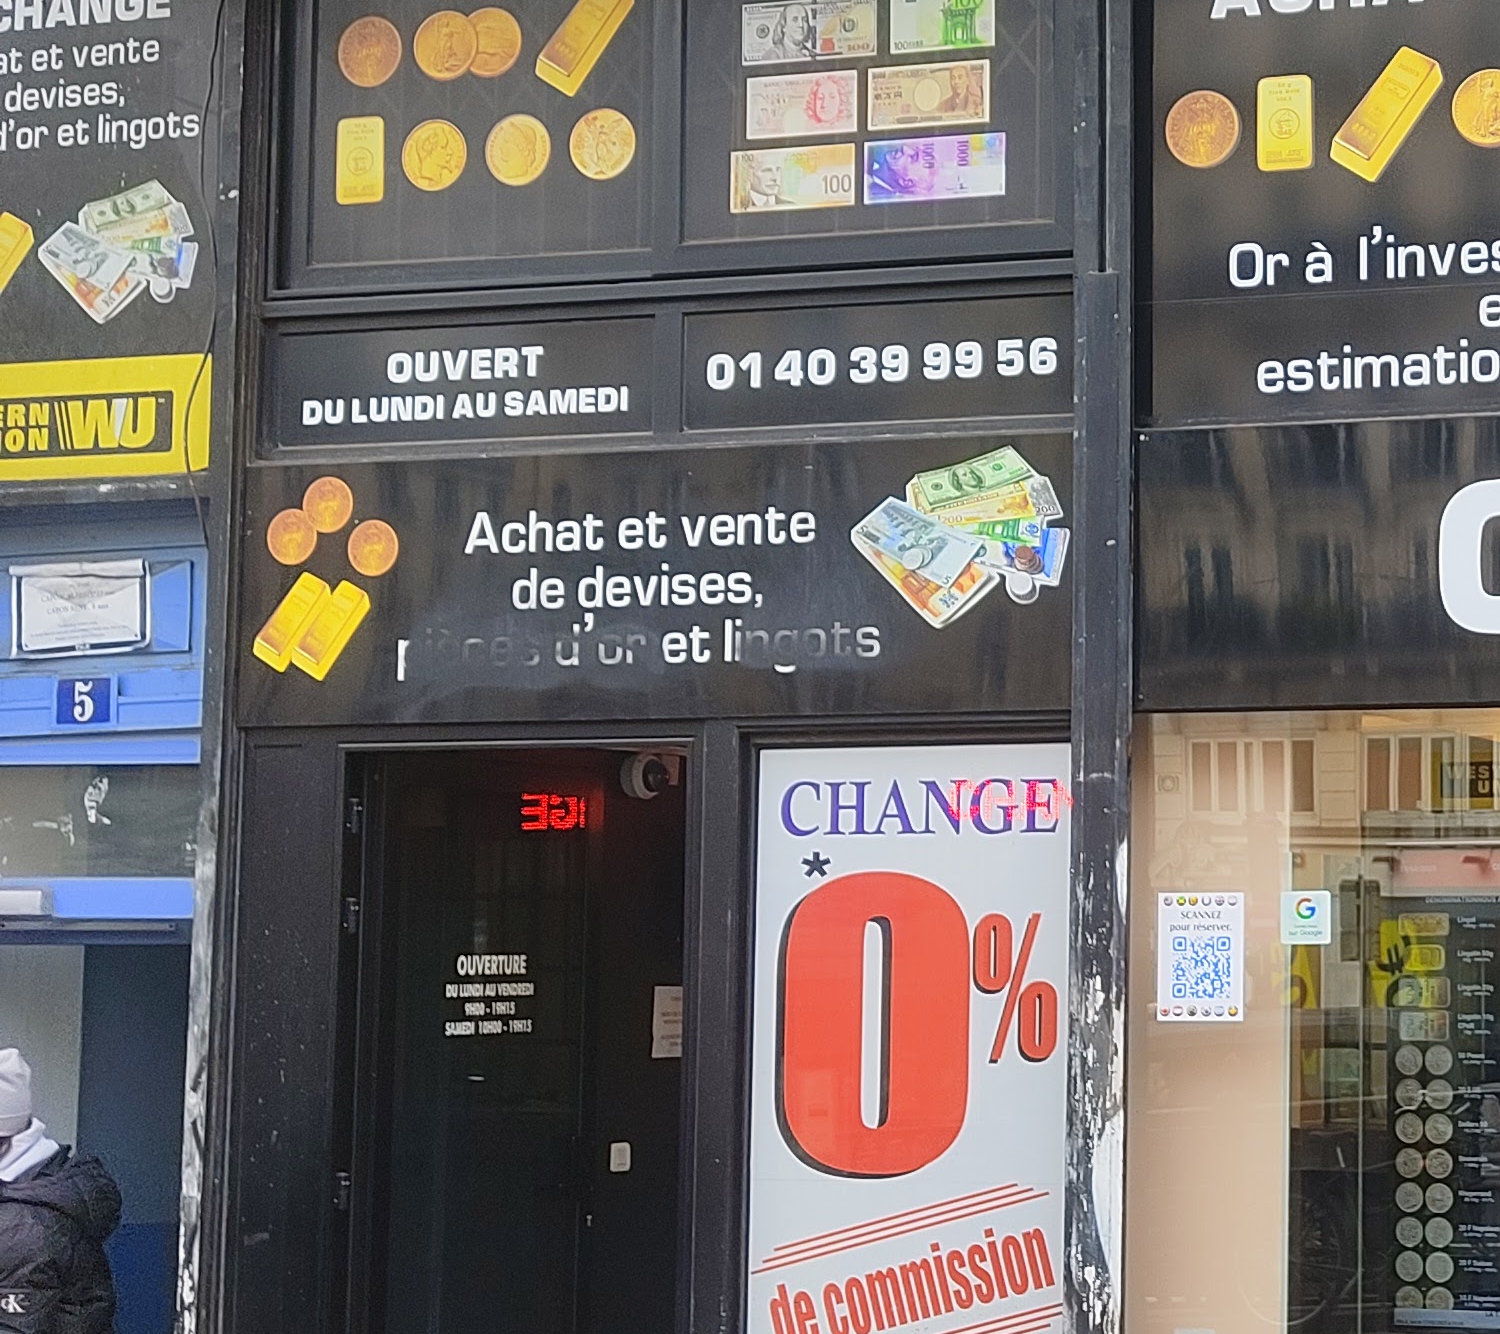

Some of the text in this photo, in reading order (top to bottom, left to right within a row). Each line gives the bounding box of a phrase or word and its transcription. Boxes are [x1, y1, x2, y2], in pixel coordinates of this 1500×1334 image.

[32, 43, 63, 72] et
[73, 38, 160, 68] vente
[5, 78, 125, 113] devises,
[58, 119, 89, 147] et
[98, 111, 199, 150] lingots
[822, 174, 851, 194] 100
[1228, 242, 1289, 288] Or
[1305, 240, 1331, 284] à
[386, 346, 544, 384] OUVERT
[706, 336, 1058, 392] 01 40 39 99 56
[0, 397, 155, 450] RN WU
[302, 385, 629, 426] DU LUNDI AU SAMEDI
[0, 428, 48, 452] ON
[465, 506, 816, 554] Achat et vente
[512, 566, 764, 611] de devises,
[661, 627, 710, 664] et
[724, 619, 880, 673] lingots
[74, 680, 94, 722] 5
[781, 779, 1059, 836] CHANGE
[1170, 924, 1190, 932] pour
[1181, 911, 1221, 919] SCANNEZ
[457, 955, 527, 976] OUVERTURE
[446, 982, 534, 998] DU LUNDI AU VENDREDI
[445, 1021, 475, 1036] SAMEDI
